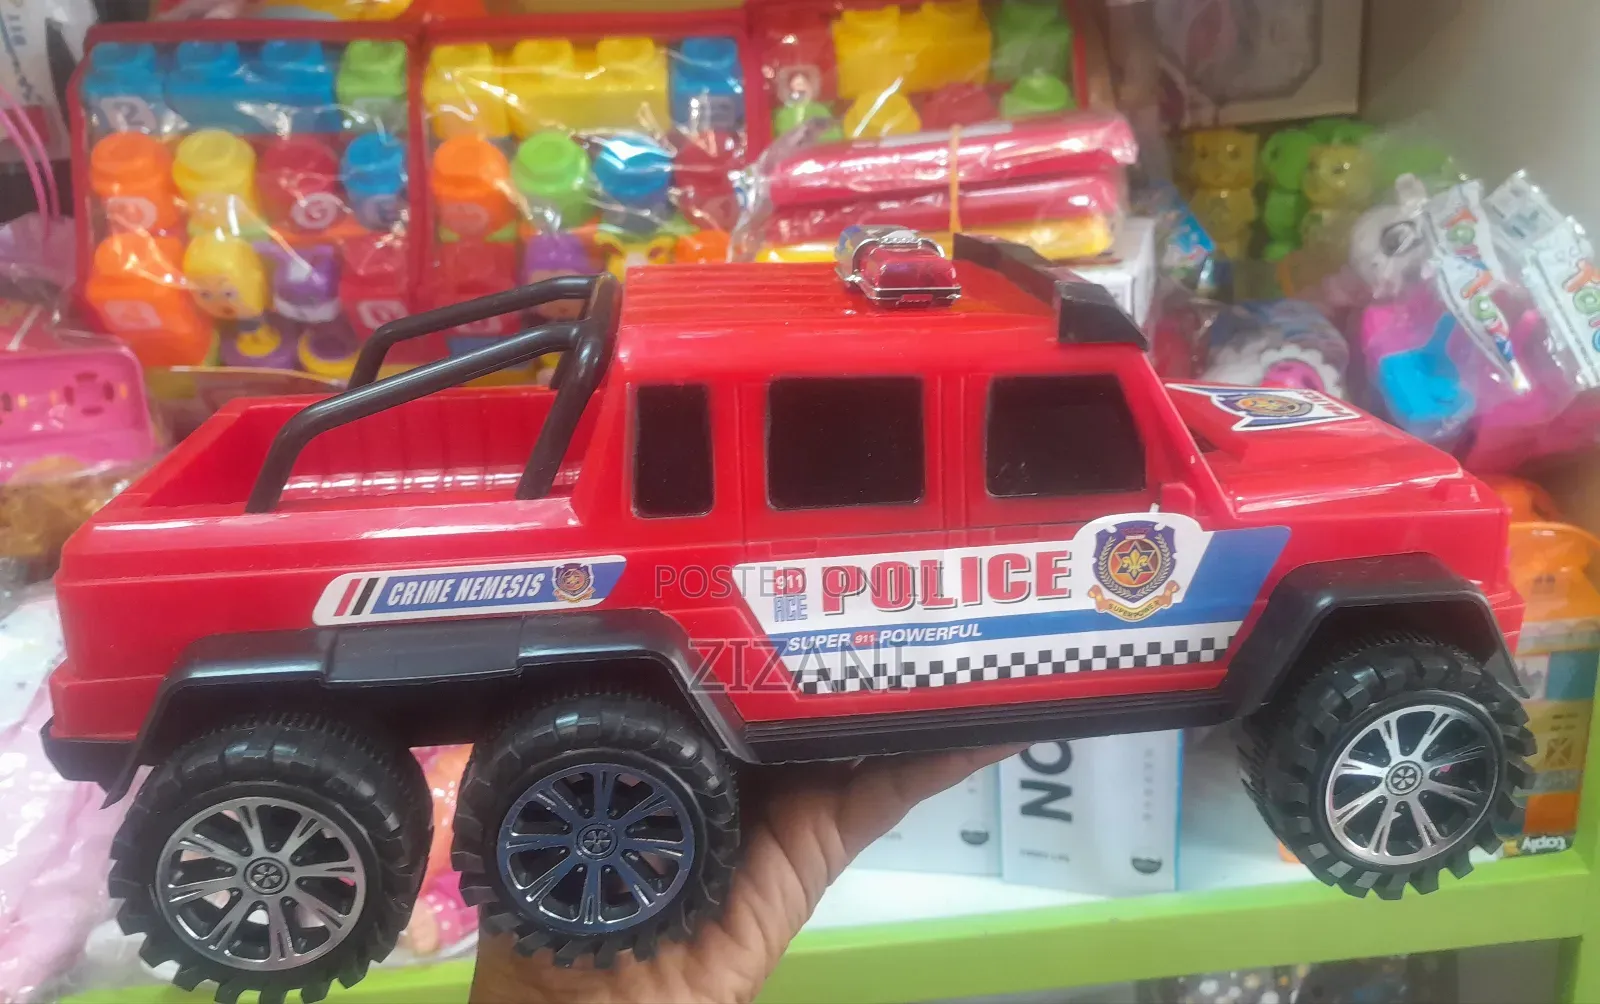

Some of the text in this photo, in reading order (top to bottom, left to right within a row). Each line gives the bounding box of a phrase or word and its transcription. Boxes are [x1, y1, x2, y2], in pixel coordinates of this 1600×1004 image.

[386, 573, 545, 607] CRIME NEMESIS
[775, 574, 803, 590] 911
[821, 550, 1073, 616] POLICE
[788, 623, 983, 652] SUPER 911 POWERFUL
